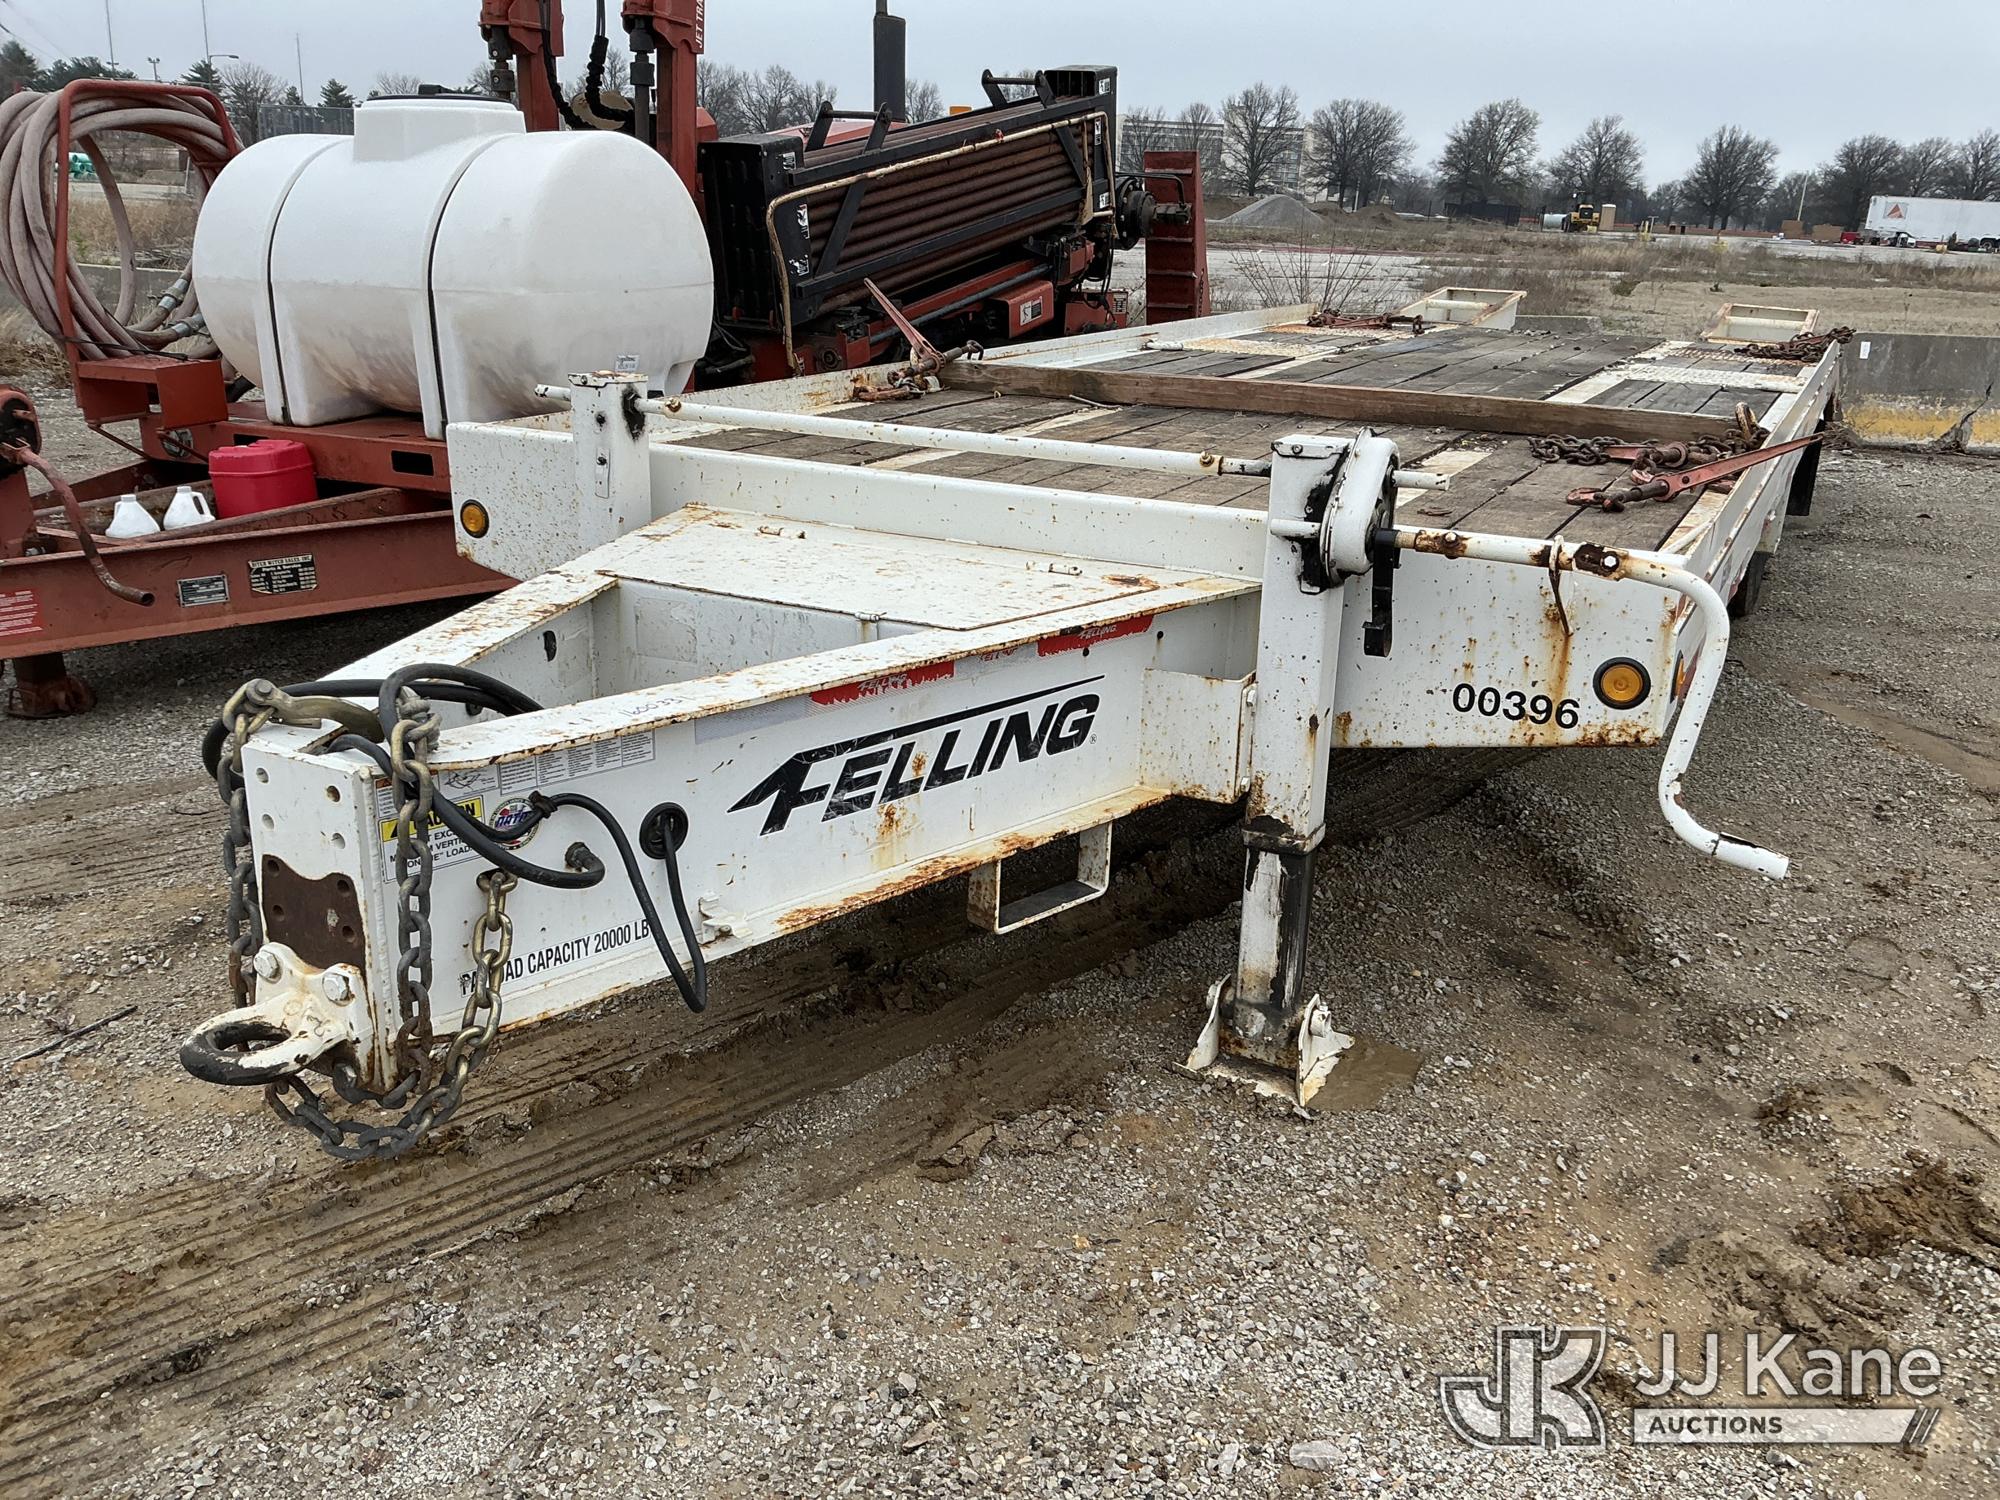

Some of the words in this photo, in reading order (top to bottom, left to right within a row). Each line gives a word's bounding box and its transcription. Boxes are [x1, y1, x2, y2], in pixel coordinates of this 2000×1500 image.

[695, 23, 703, 48] JET
[1453, 683, 1580, 729] 00396
[727, 676, 1105, 837] FELLING
[527, 935, 591, 975] CAPACITY
[593, 924, 631, 954] 20000
